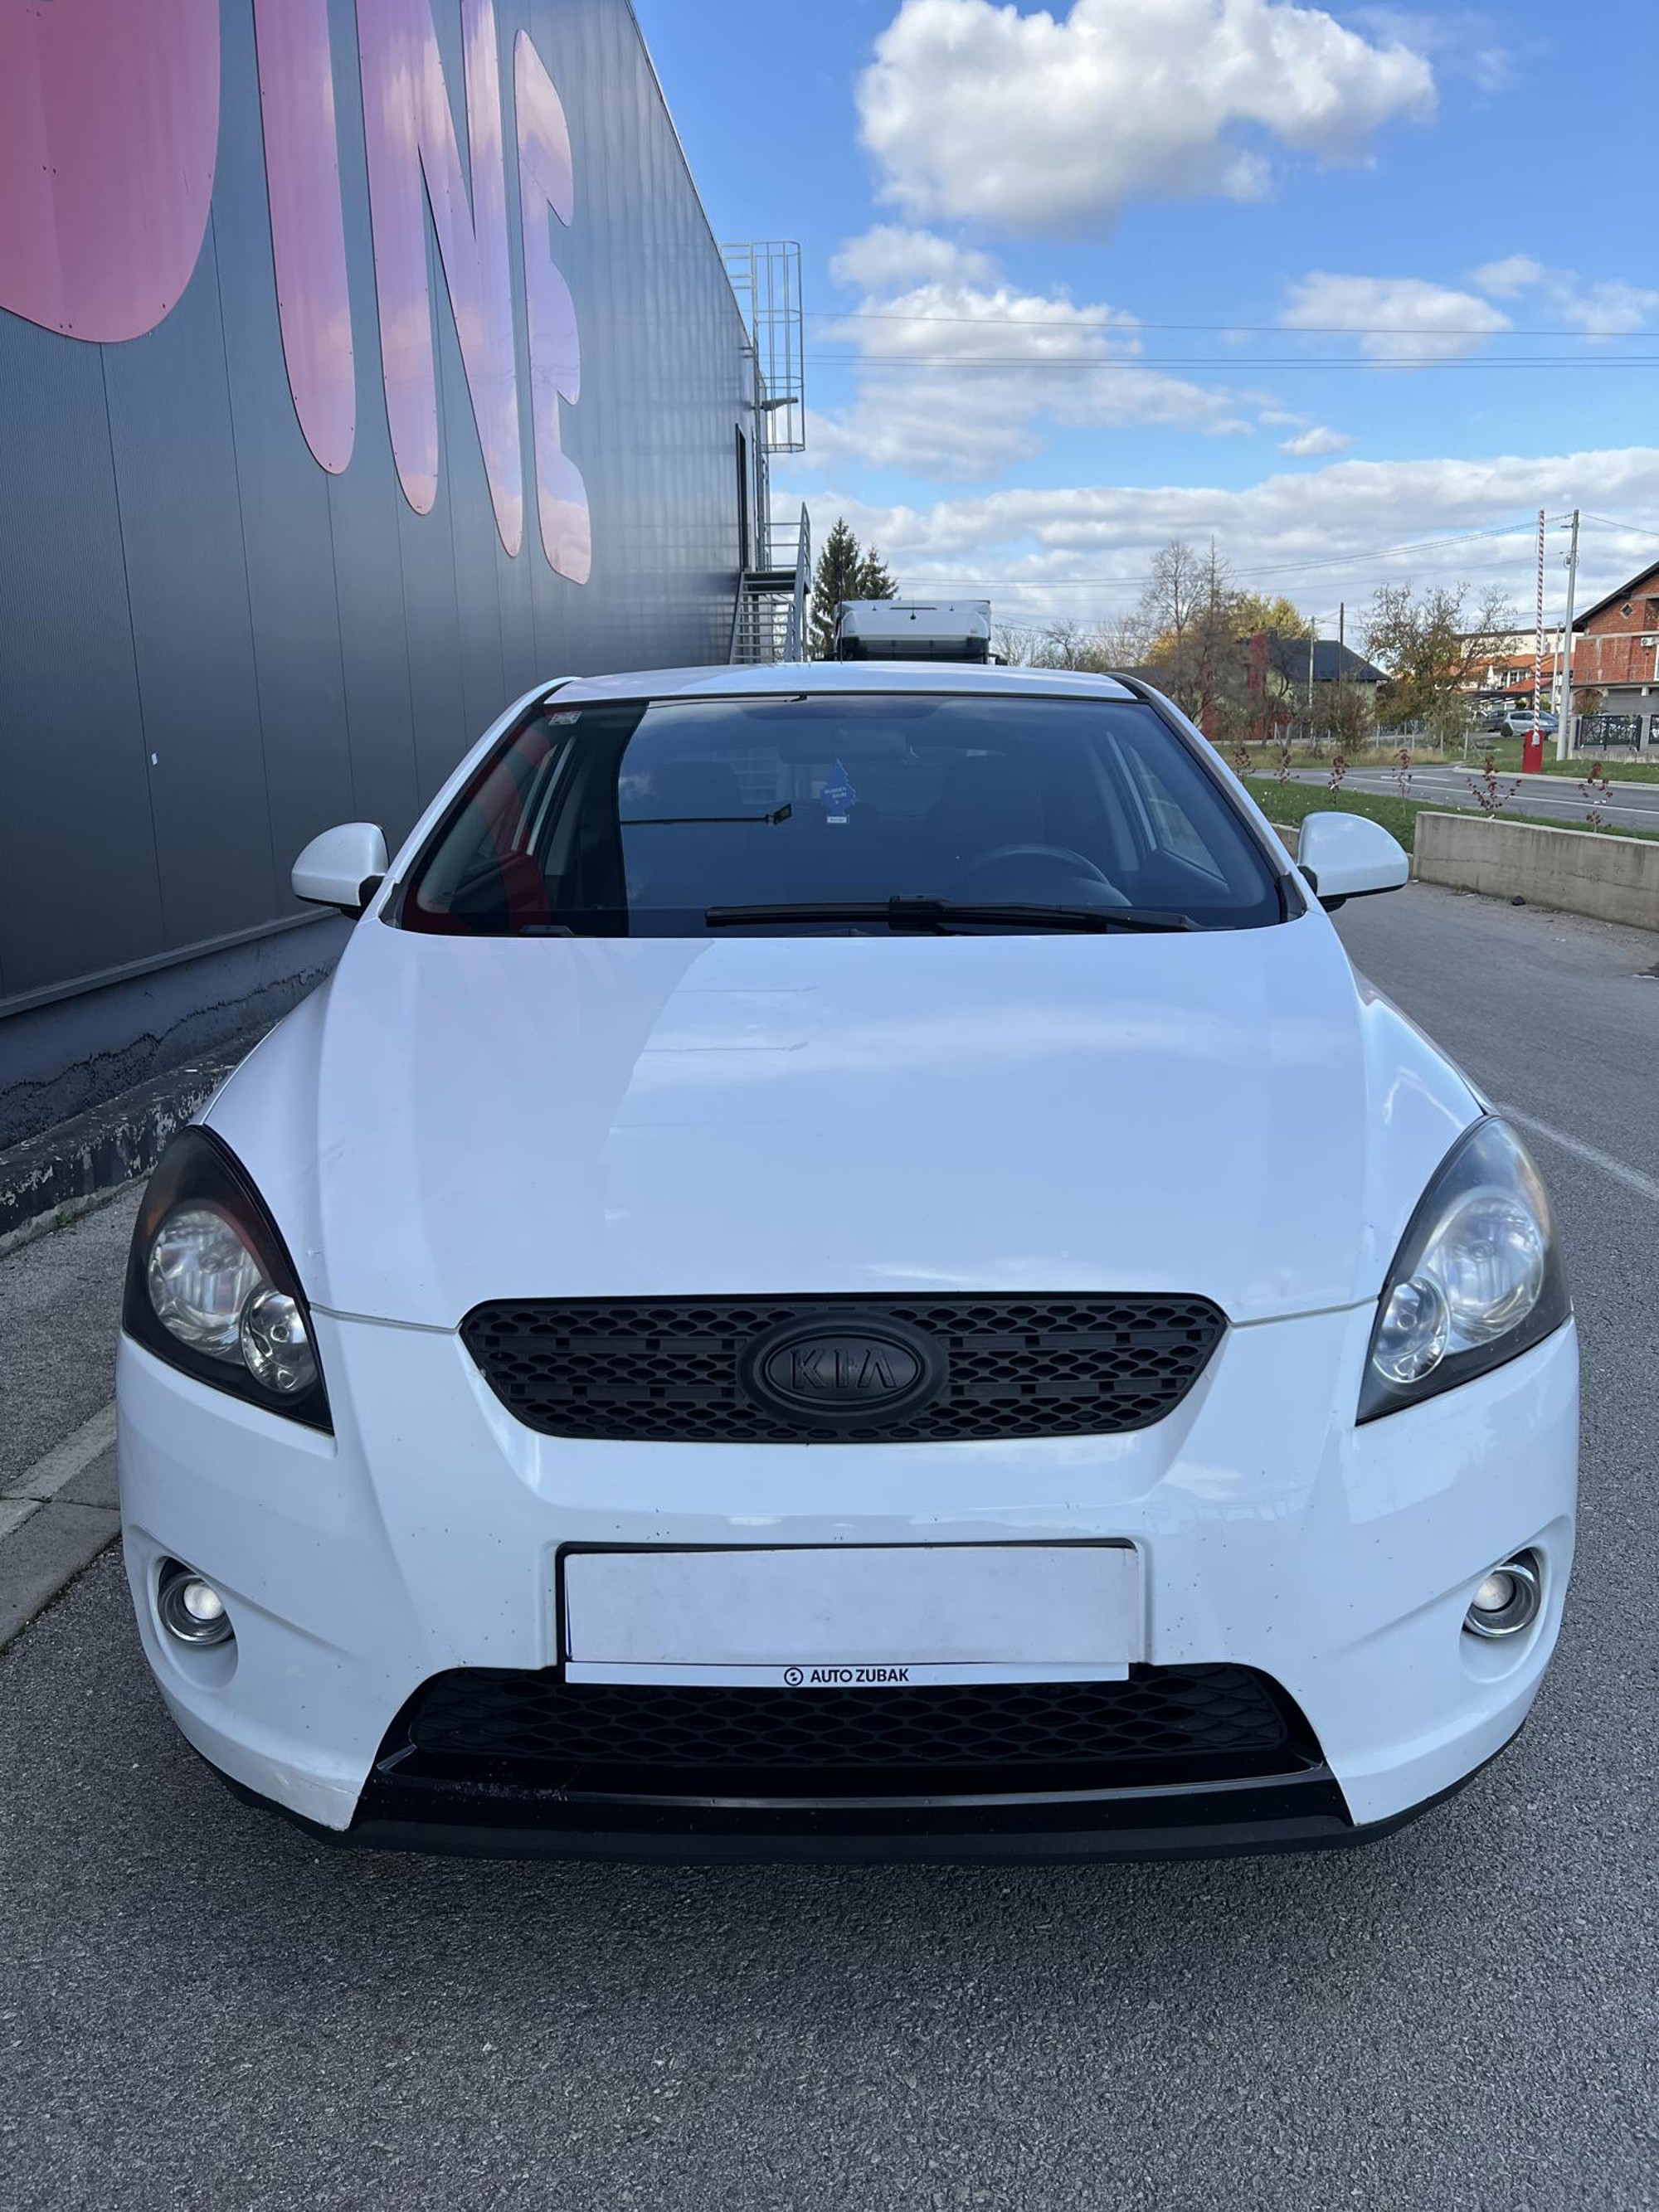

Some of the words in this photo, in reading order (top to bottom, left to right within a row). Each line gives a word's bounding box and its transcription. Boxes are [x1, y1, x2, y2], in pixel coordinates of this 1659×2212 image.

[791, 1348, 897, 1389] KIA
[810, 1669, 854, 1684] AUTO
[855, 1668, 910, 1683] ZUBAK
